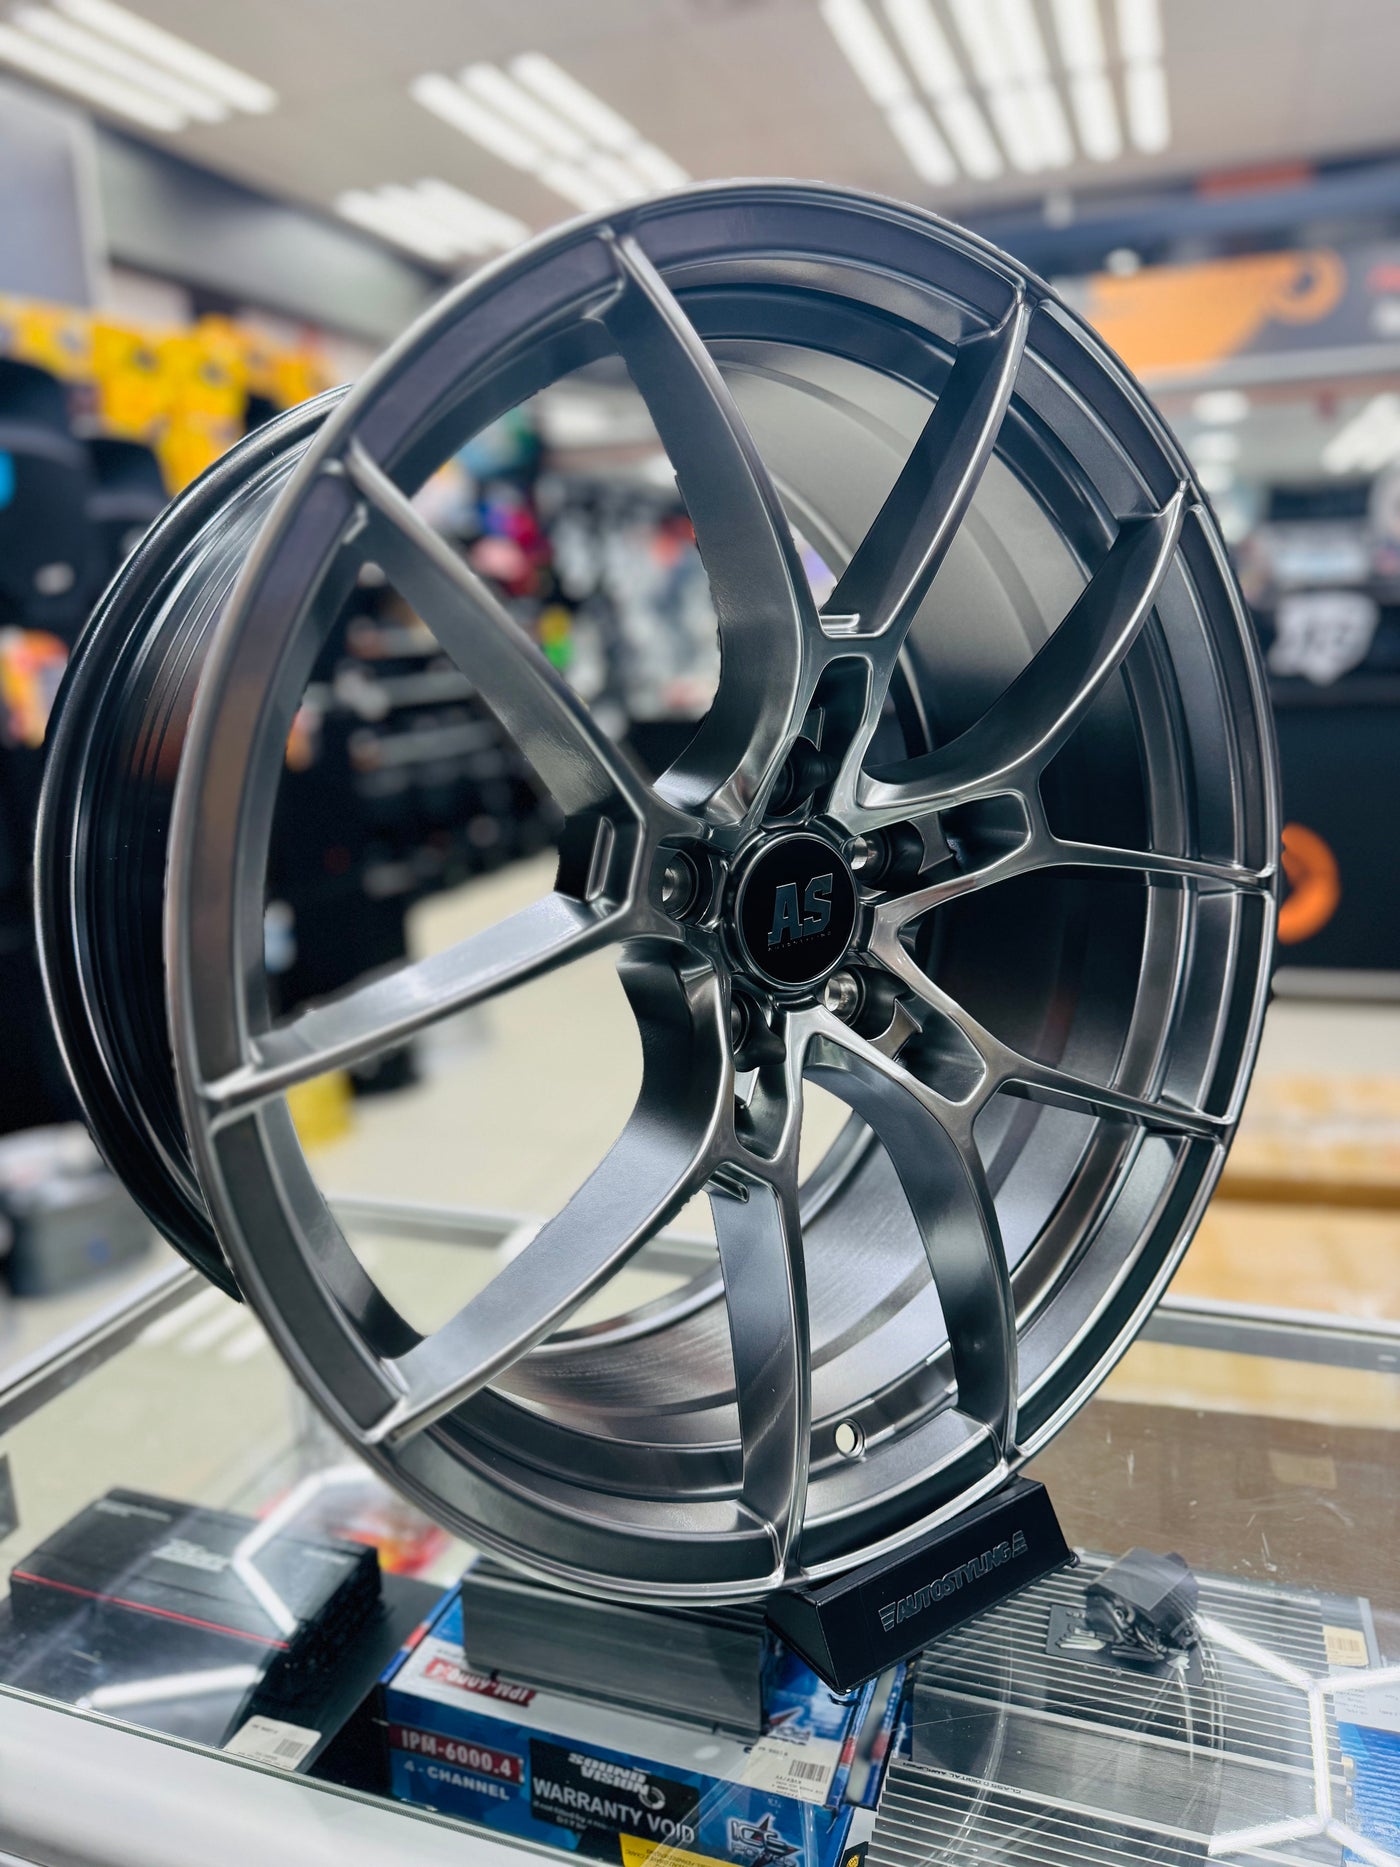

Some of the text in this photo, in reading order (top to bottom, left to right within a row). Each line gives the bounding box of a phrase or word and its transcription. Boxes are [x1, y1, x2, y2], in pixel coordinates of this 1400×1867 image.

[767, 873, 833, 946] AS
[896, 1541, 1012, 1624] AUTOSTYLING
[401, 1729, 512, 1777] IPM-6000.4
[568, 1752, 647, 1784] SOUND
[427, 1765, 510, 1800] CHANNEL
[580, 1765, 650, 1796] VISION
[532, 1776, 643, 1827] WARRANTY
[646, 1813, 695, 1844] VOID
